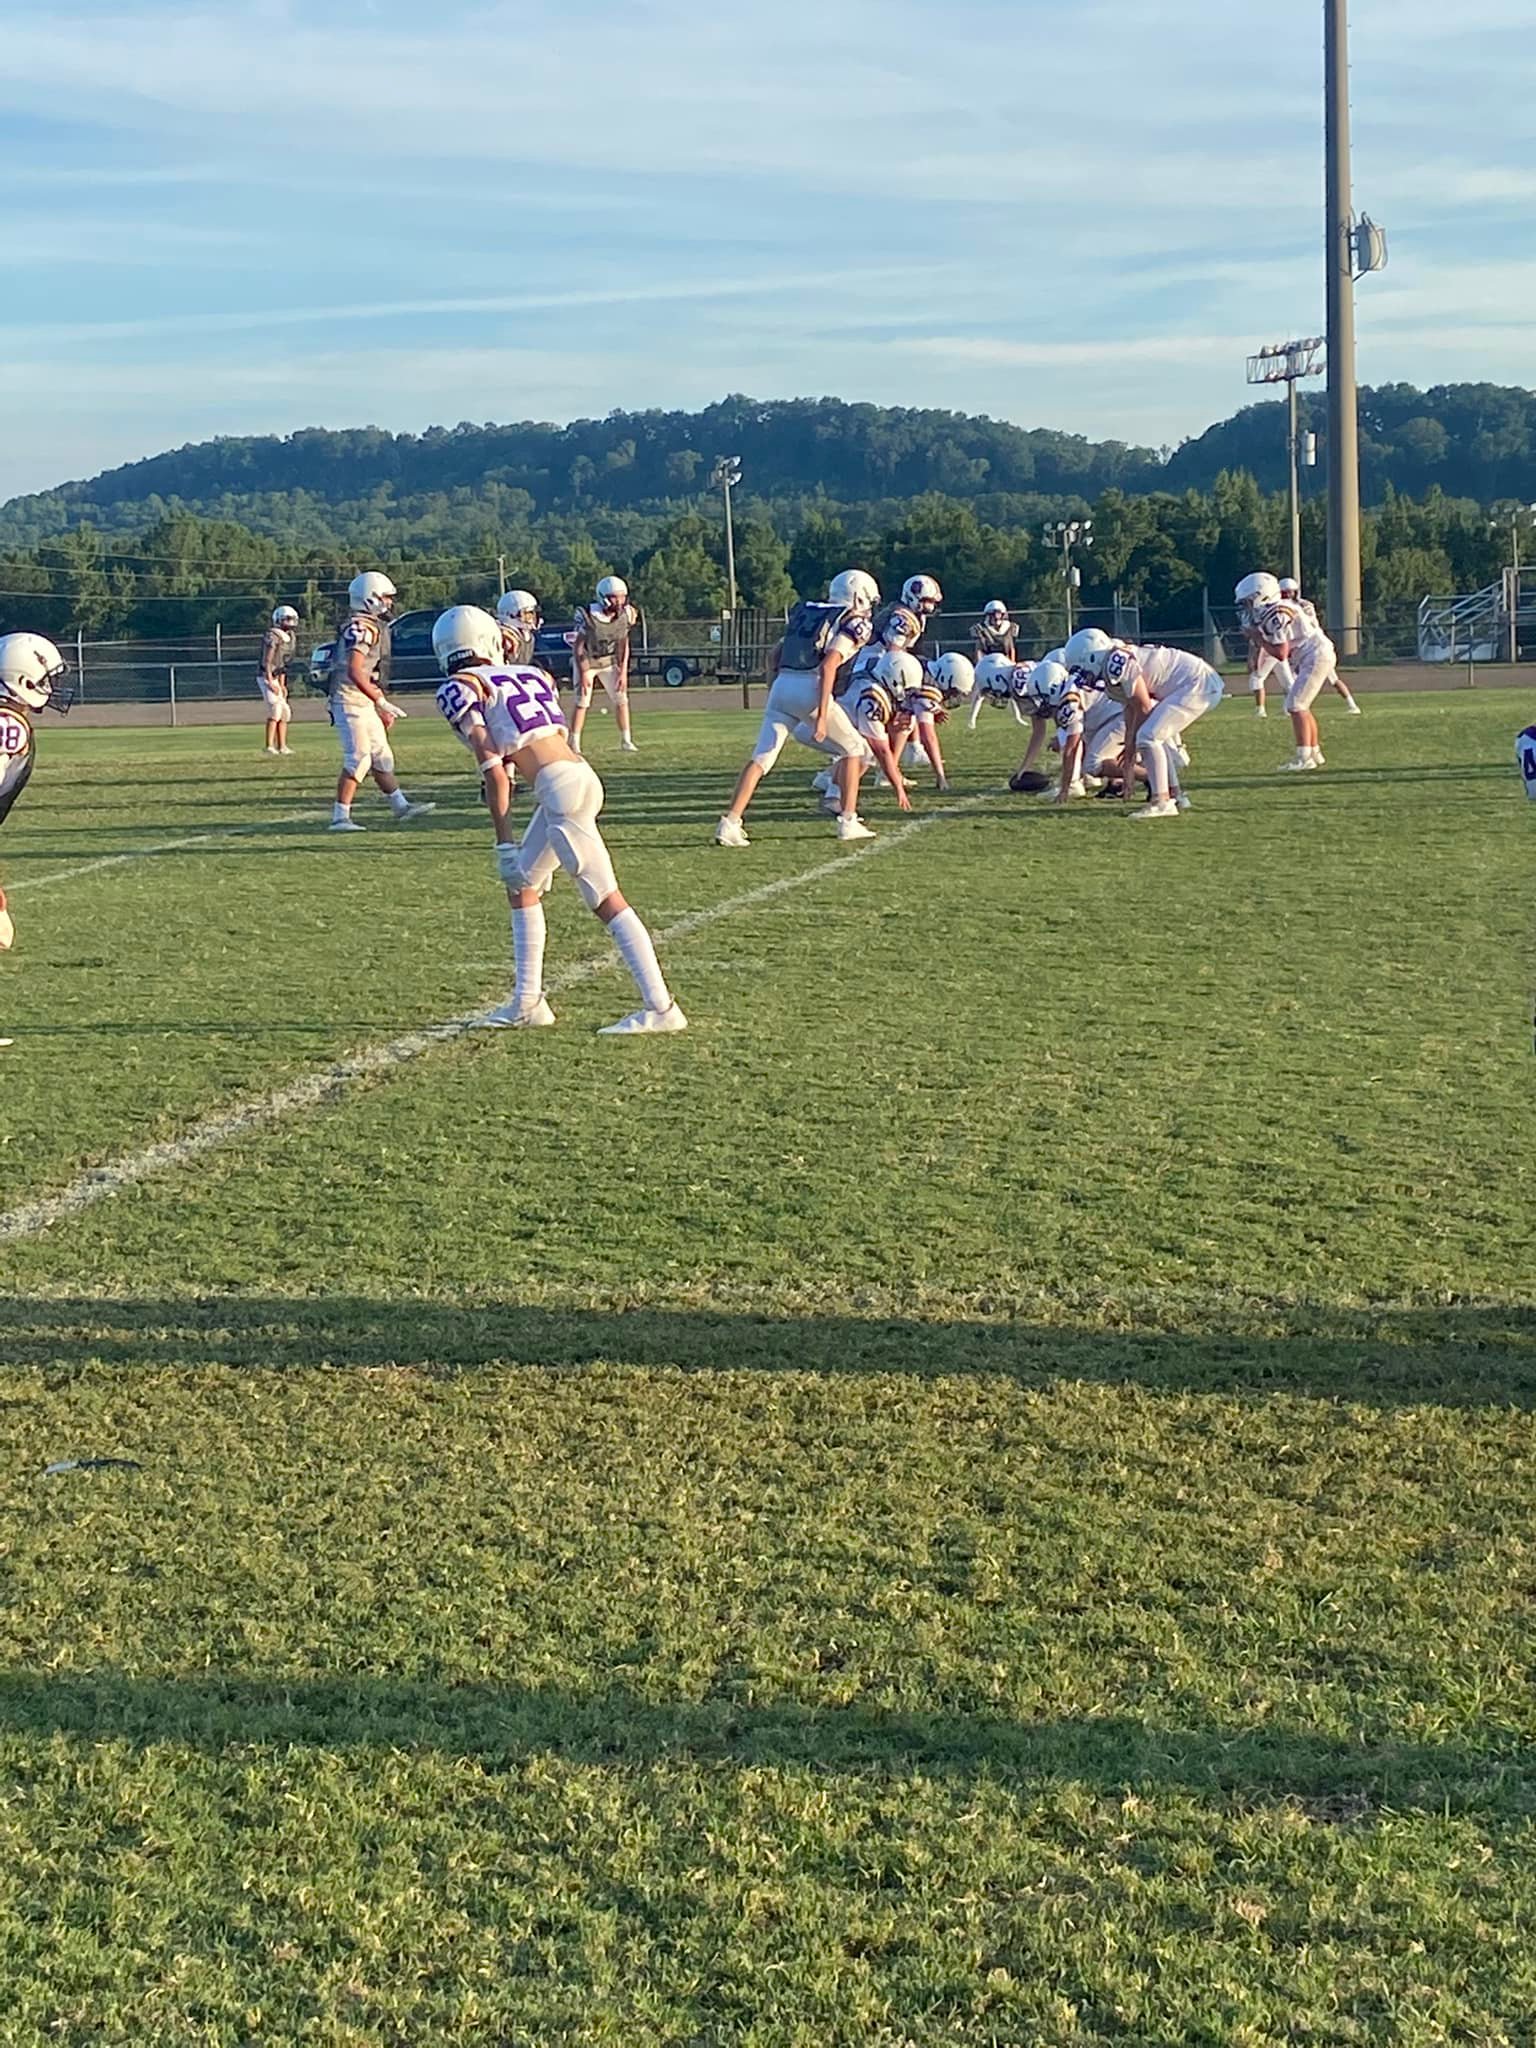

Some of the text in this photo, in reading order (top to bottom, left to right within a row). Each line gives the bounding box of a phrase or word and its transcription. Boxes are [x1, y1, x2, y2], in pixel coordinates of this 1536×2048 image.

[1109, 652, 1126, 677] 68
[436, 684, 468, 720] 22
[490, 673, 566, 734] 22
[0, 725, 20, 750] 8
